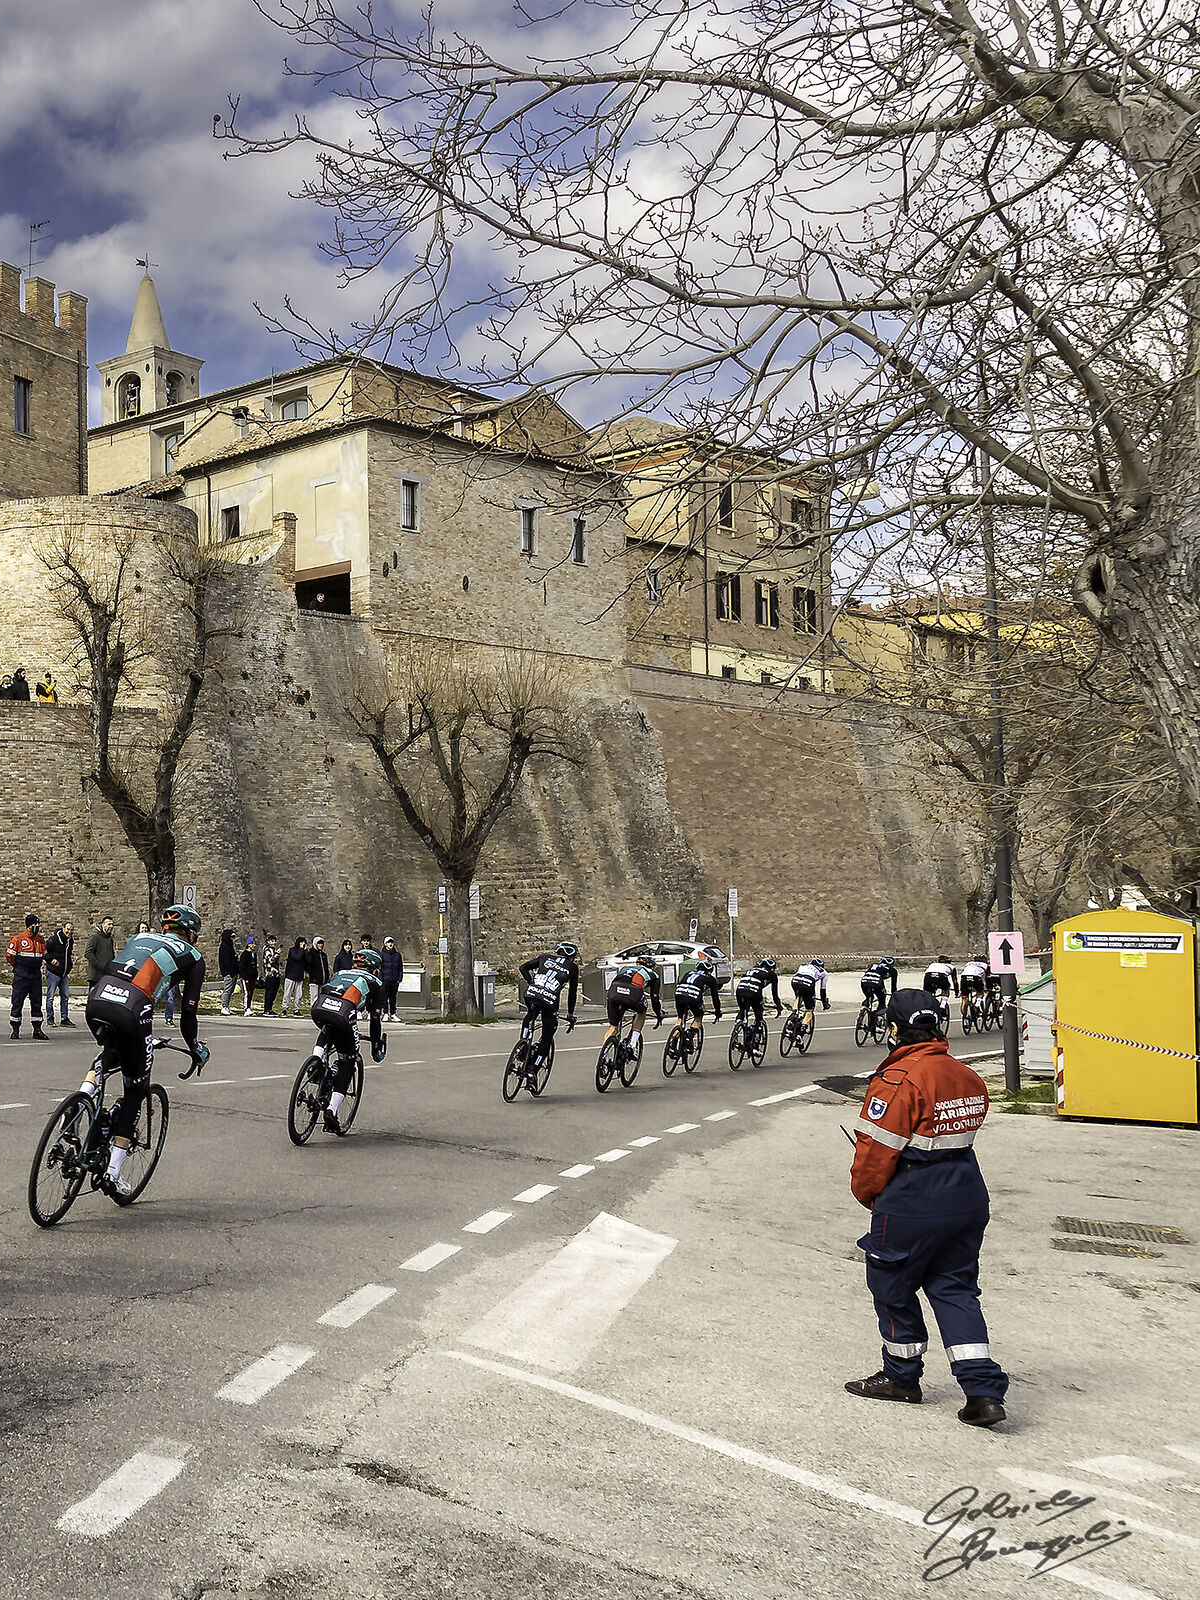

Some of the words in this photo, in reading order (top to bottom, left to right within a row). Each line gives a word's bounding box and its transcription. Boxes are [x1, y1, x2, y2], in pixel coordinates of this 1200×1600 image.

[103, 983, 130, 998] BORA
[324, 997, 343, 1007] BORA
[352, 1024, 361, 1051] BORA
[144, 1034, 154, 1071] BORA
